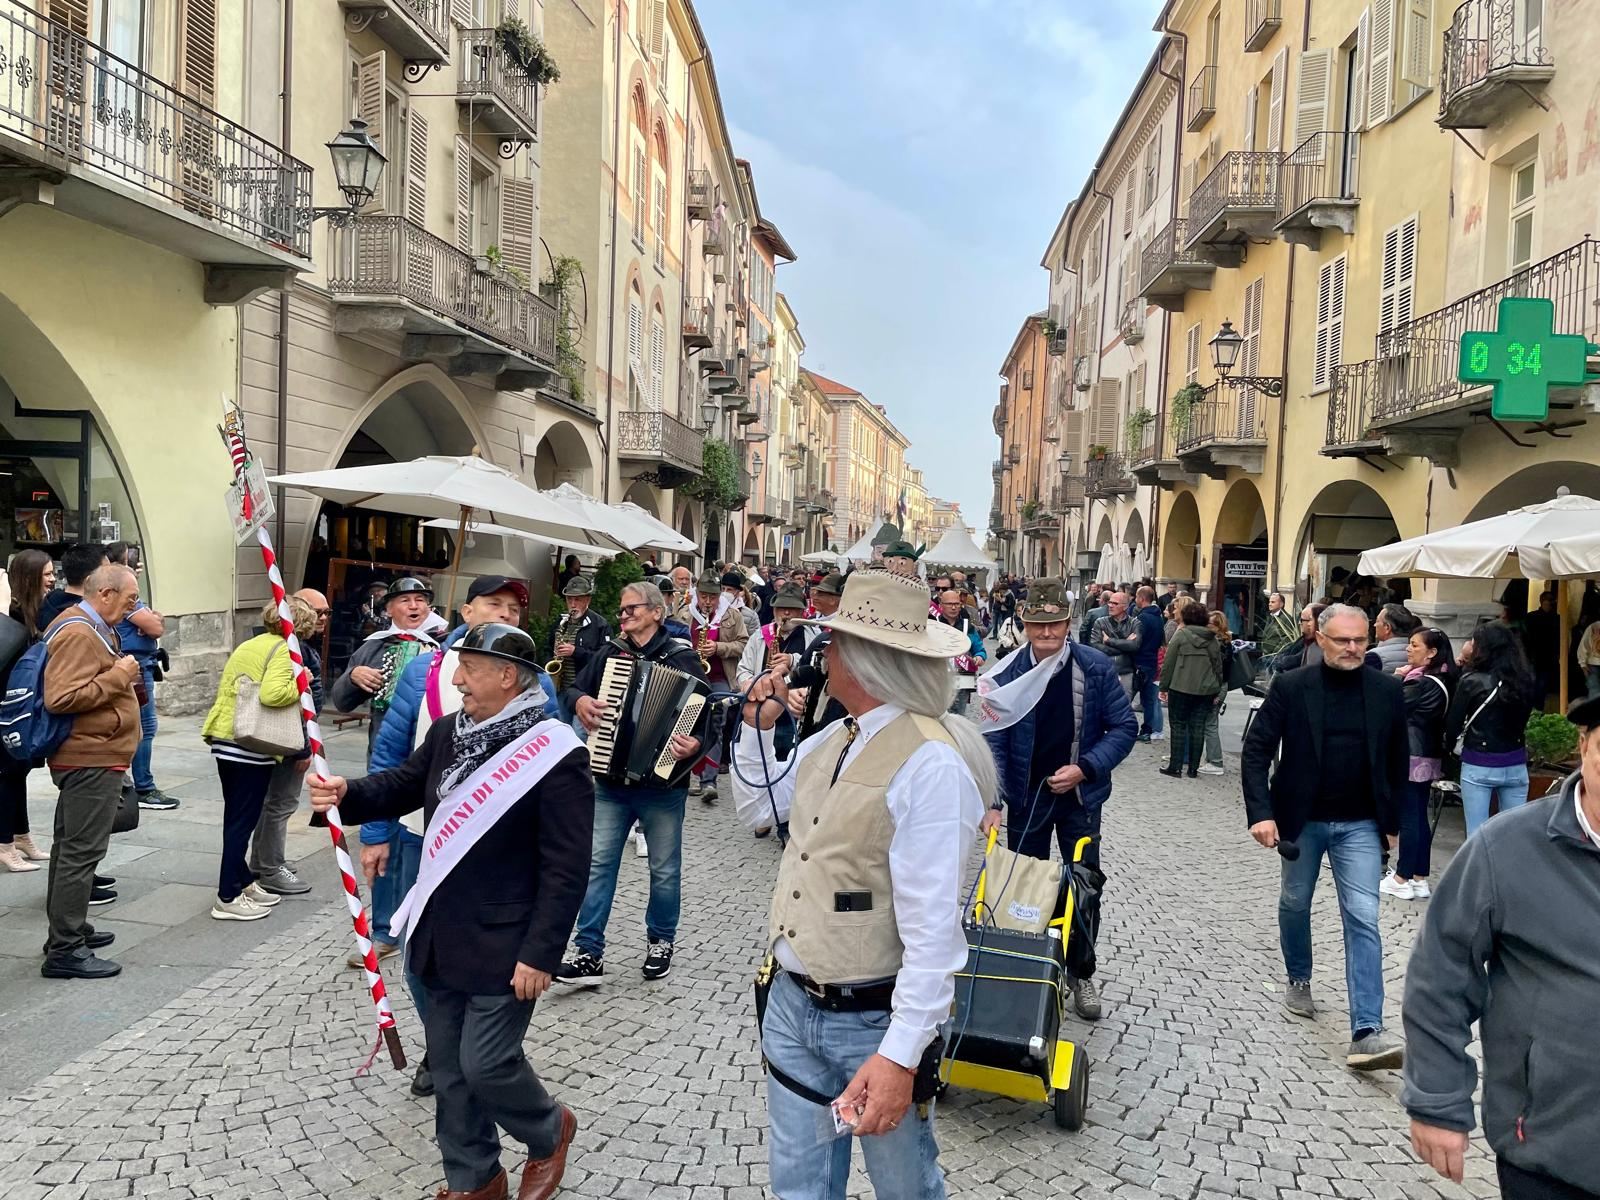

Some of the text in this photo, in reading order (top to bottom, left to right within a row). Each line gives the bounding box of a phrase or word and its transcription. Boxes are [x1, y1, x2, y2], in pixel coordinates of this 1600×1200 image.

[1507, 343, 1541, 375] 34
[2, 731, 22, 749] 92
[471, 782, 494, 805] DI
[491, 735, 550, 785] MONDO
